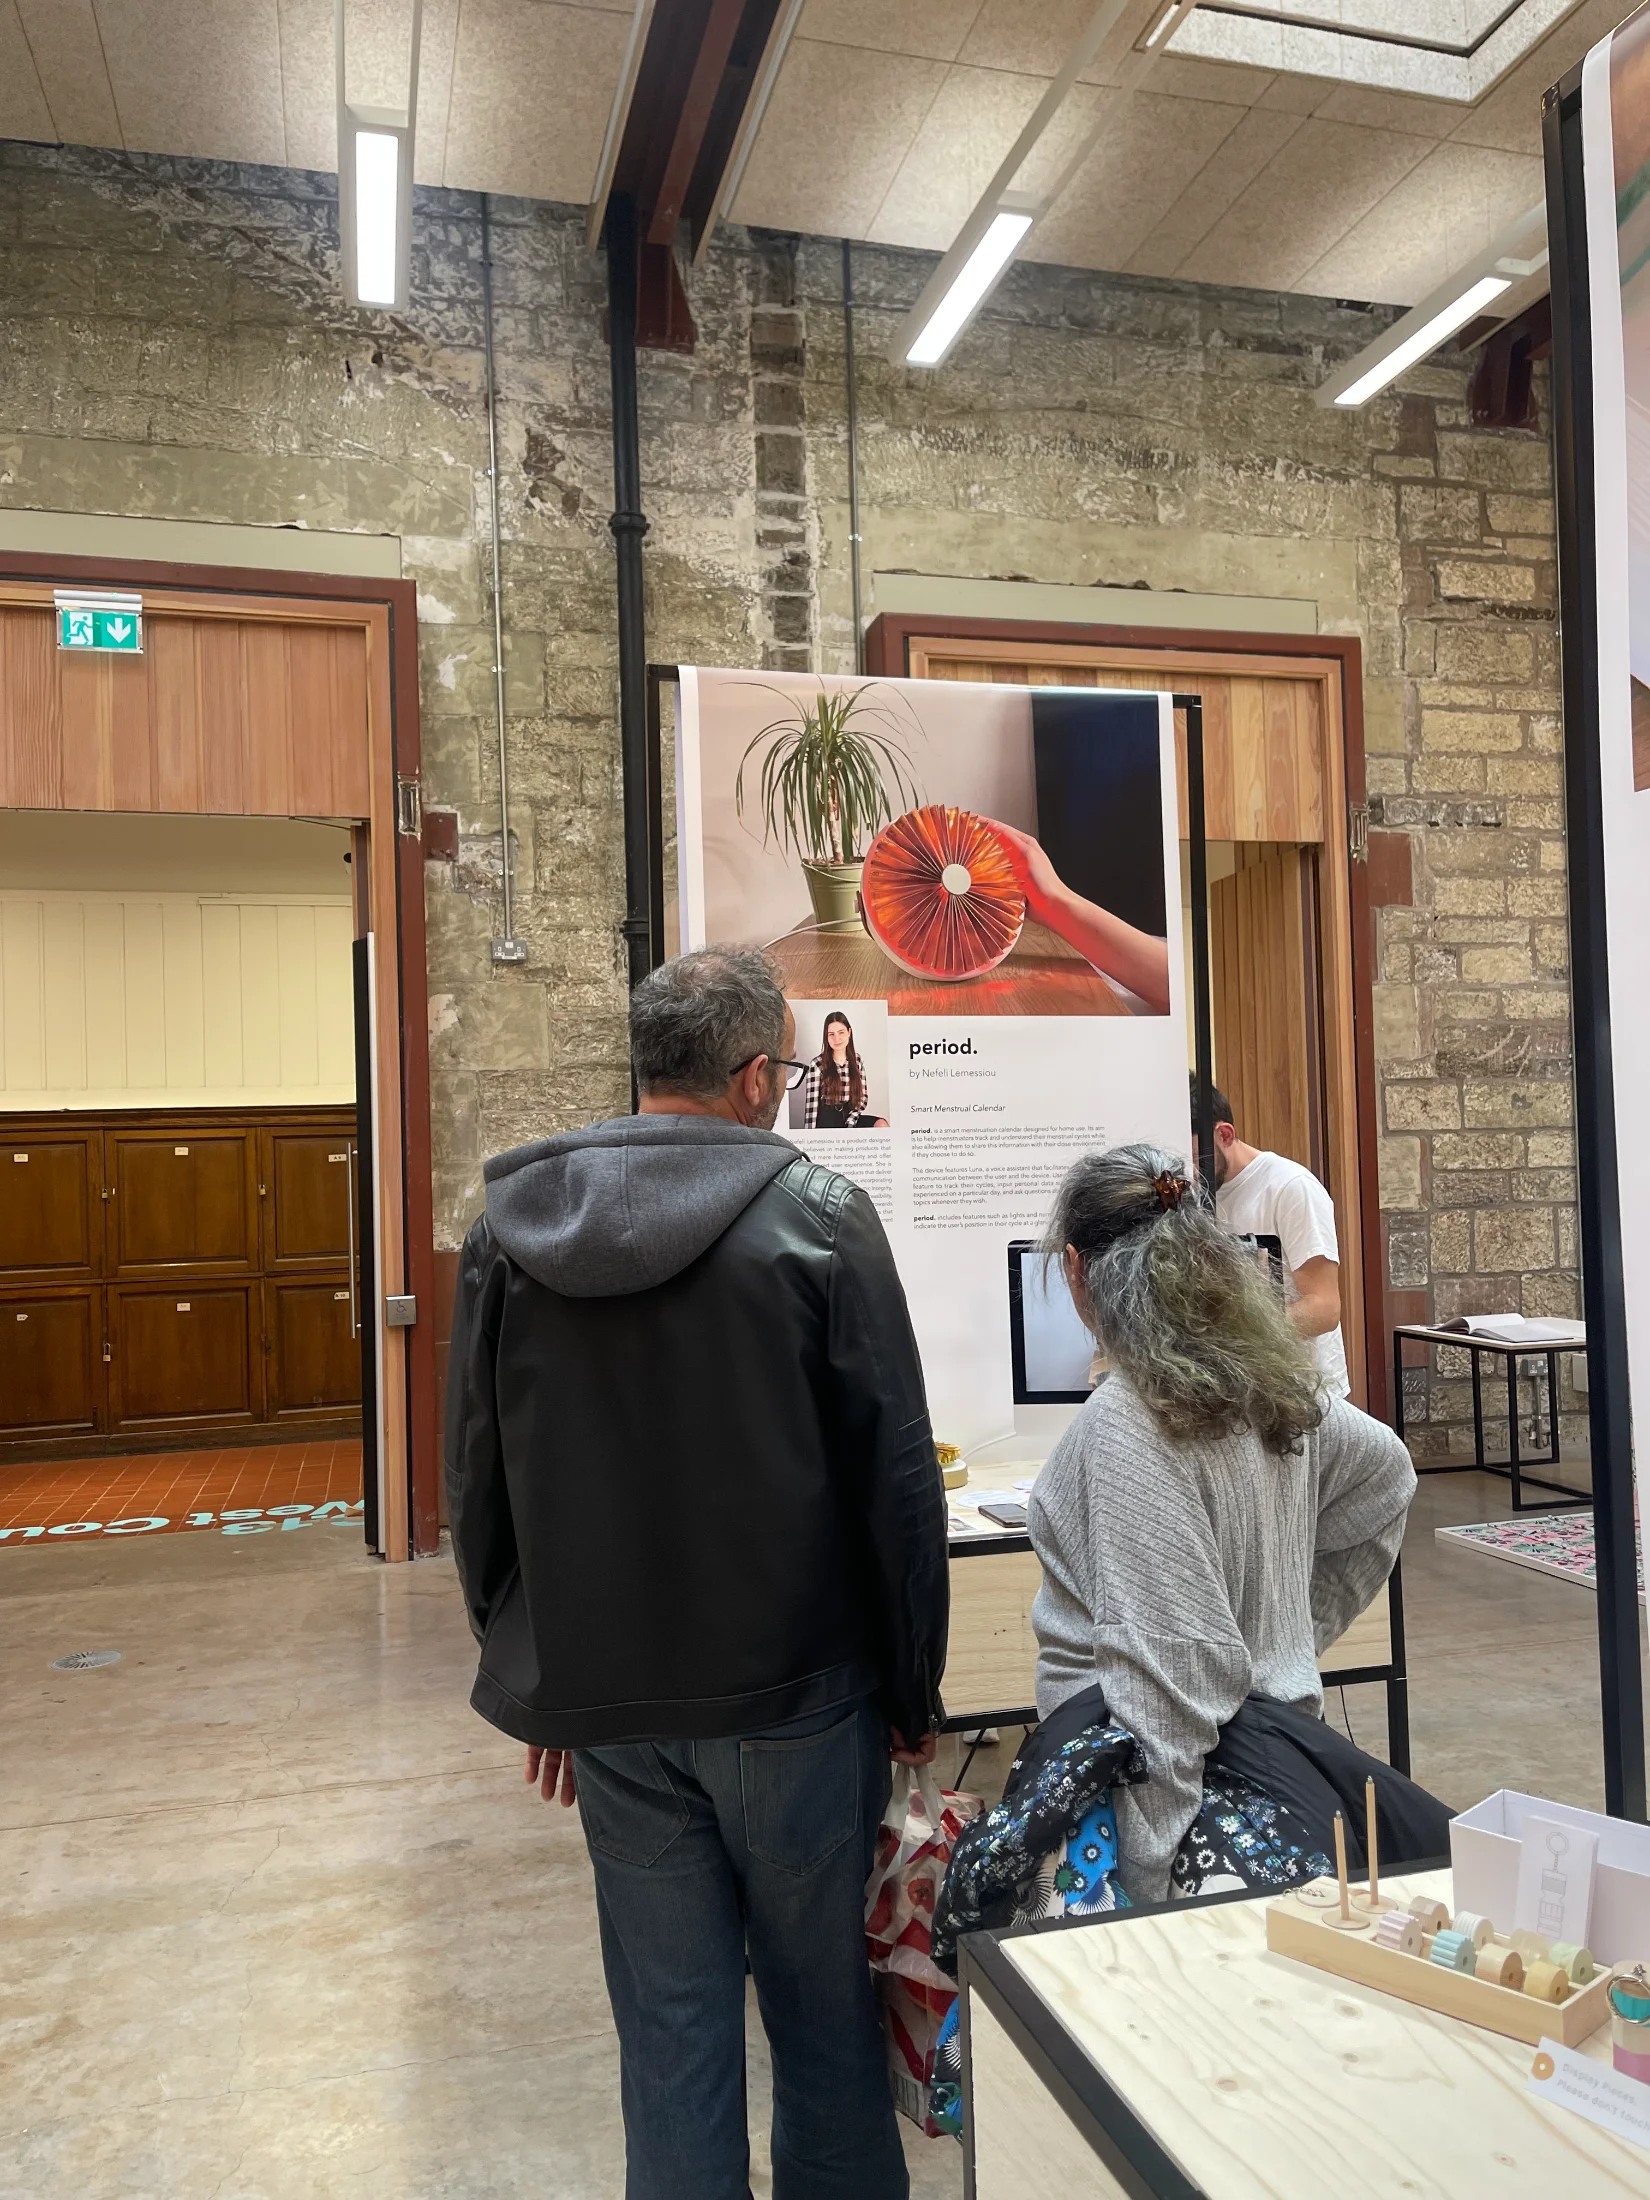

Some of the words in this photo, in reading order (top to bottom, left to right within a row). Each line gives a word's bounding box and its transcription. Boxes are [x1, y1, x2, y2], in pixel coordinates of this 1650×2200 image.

[909, 1037, 978, 1060] period.
[909, 1068, 920, 1080] by
[922, 1068, 949, 1078] Nefeli
[950, 1068, 997, 1078] Lemessiou
[910, 1104, 933, 1113] Smart
[934, 1104, 972, 1112] Menstrual
[972, 1104, 1006, 1112] Calendar
[911, 1127, 933, 1135] period.
[1023, 1125, 1049, 1133] designed
[916, 1151, 929, 1159] they
[976, 1181, 995, 1189] cycles,
[997, 1180, 1012, 1188] input
[1014, 1180, 1039, 1188] personal
[913, 1190, 948, 1198] experienced
[962, 1189, 989, 1197] particular
[989, 1188, 1002, 1197] day,
[1024, 1187, 1051, 1196] questions
[913, 1199, 931, 1207] topics
[959, 1198, 972, 1206] they
[913, 1214, 936, 1222] period.
[1009, 1212, 1025, 1220] lights
[1557, 2078, 1590, 2101] Please
